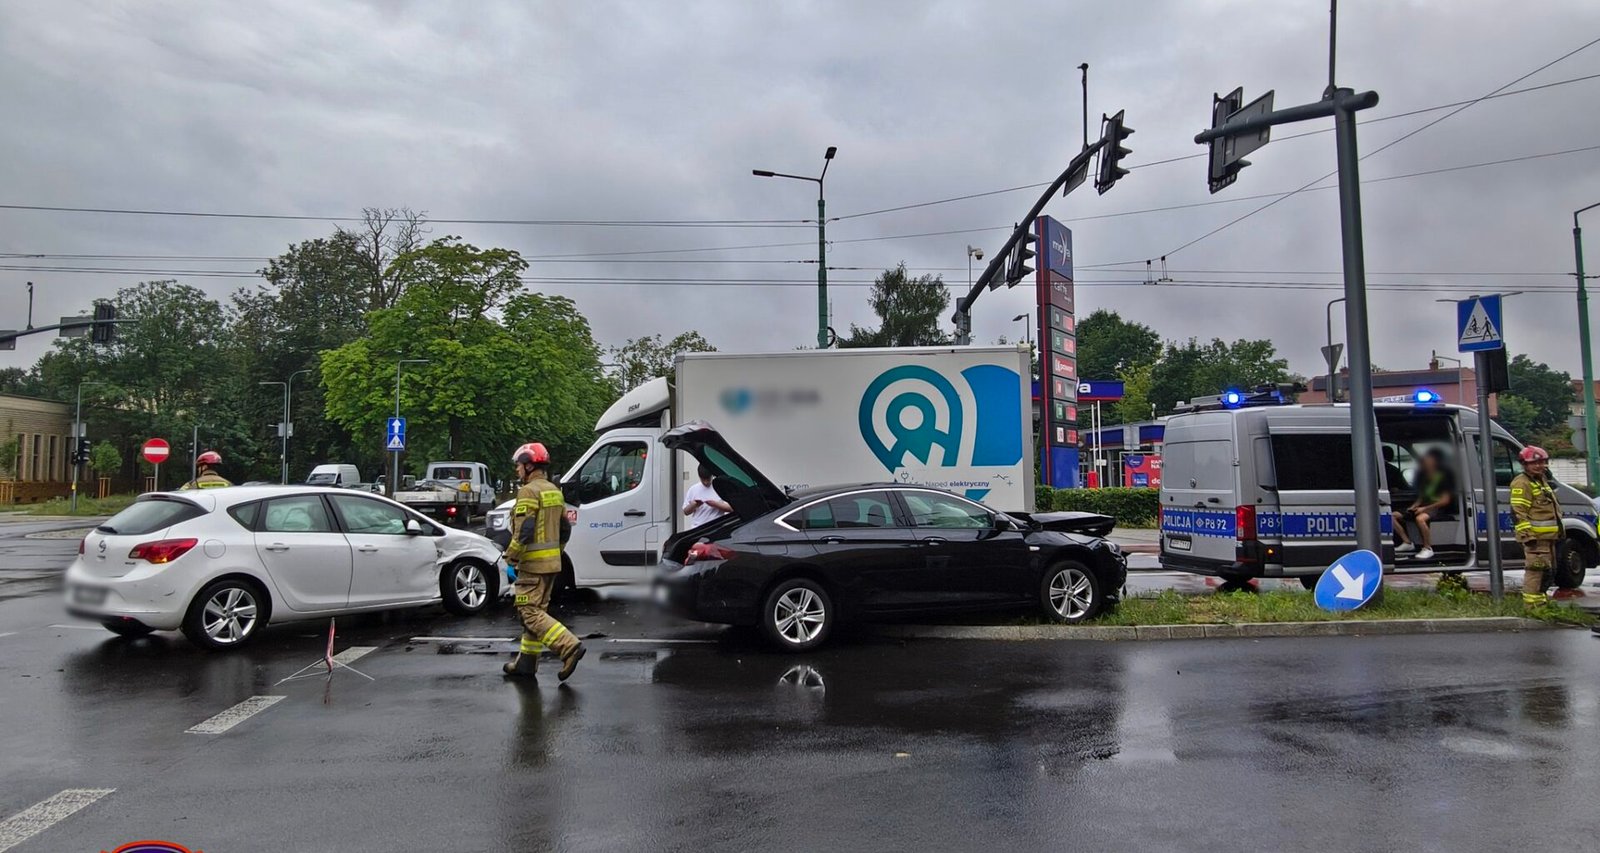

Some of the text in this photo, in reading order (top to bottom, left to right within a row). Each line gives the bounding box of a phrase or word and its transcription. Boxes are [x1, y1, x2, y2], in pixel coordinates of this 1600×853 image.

[590, 521, 623, 529] ce-ma.pl
[1163, 515, 1227, 530] POLICJA P8 92
[1260, 517, 1274, 528] P8
